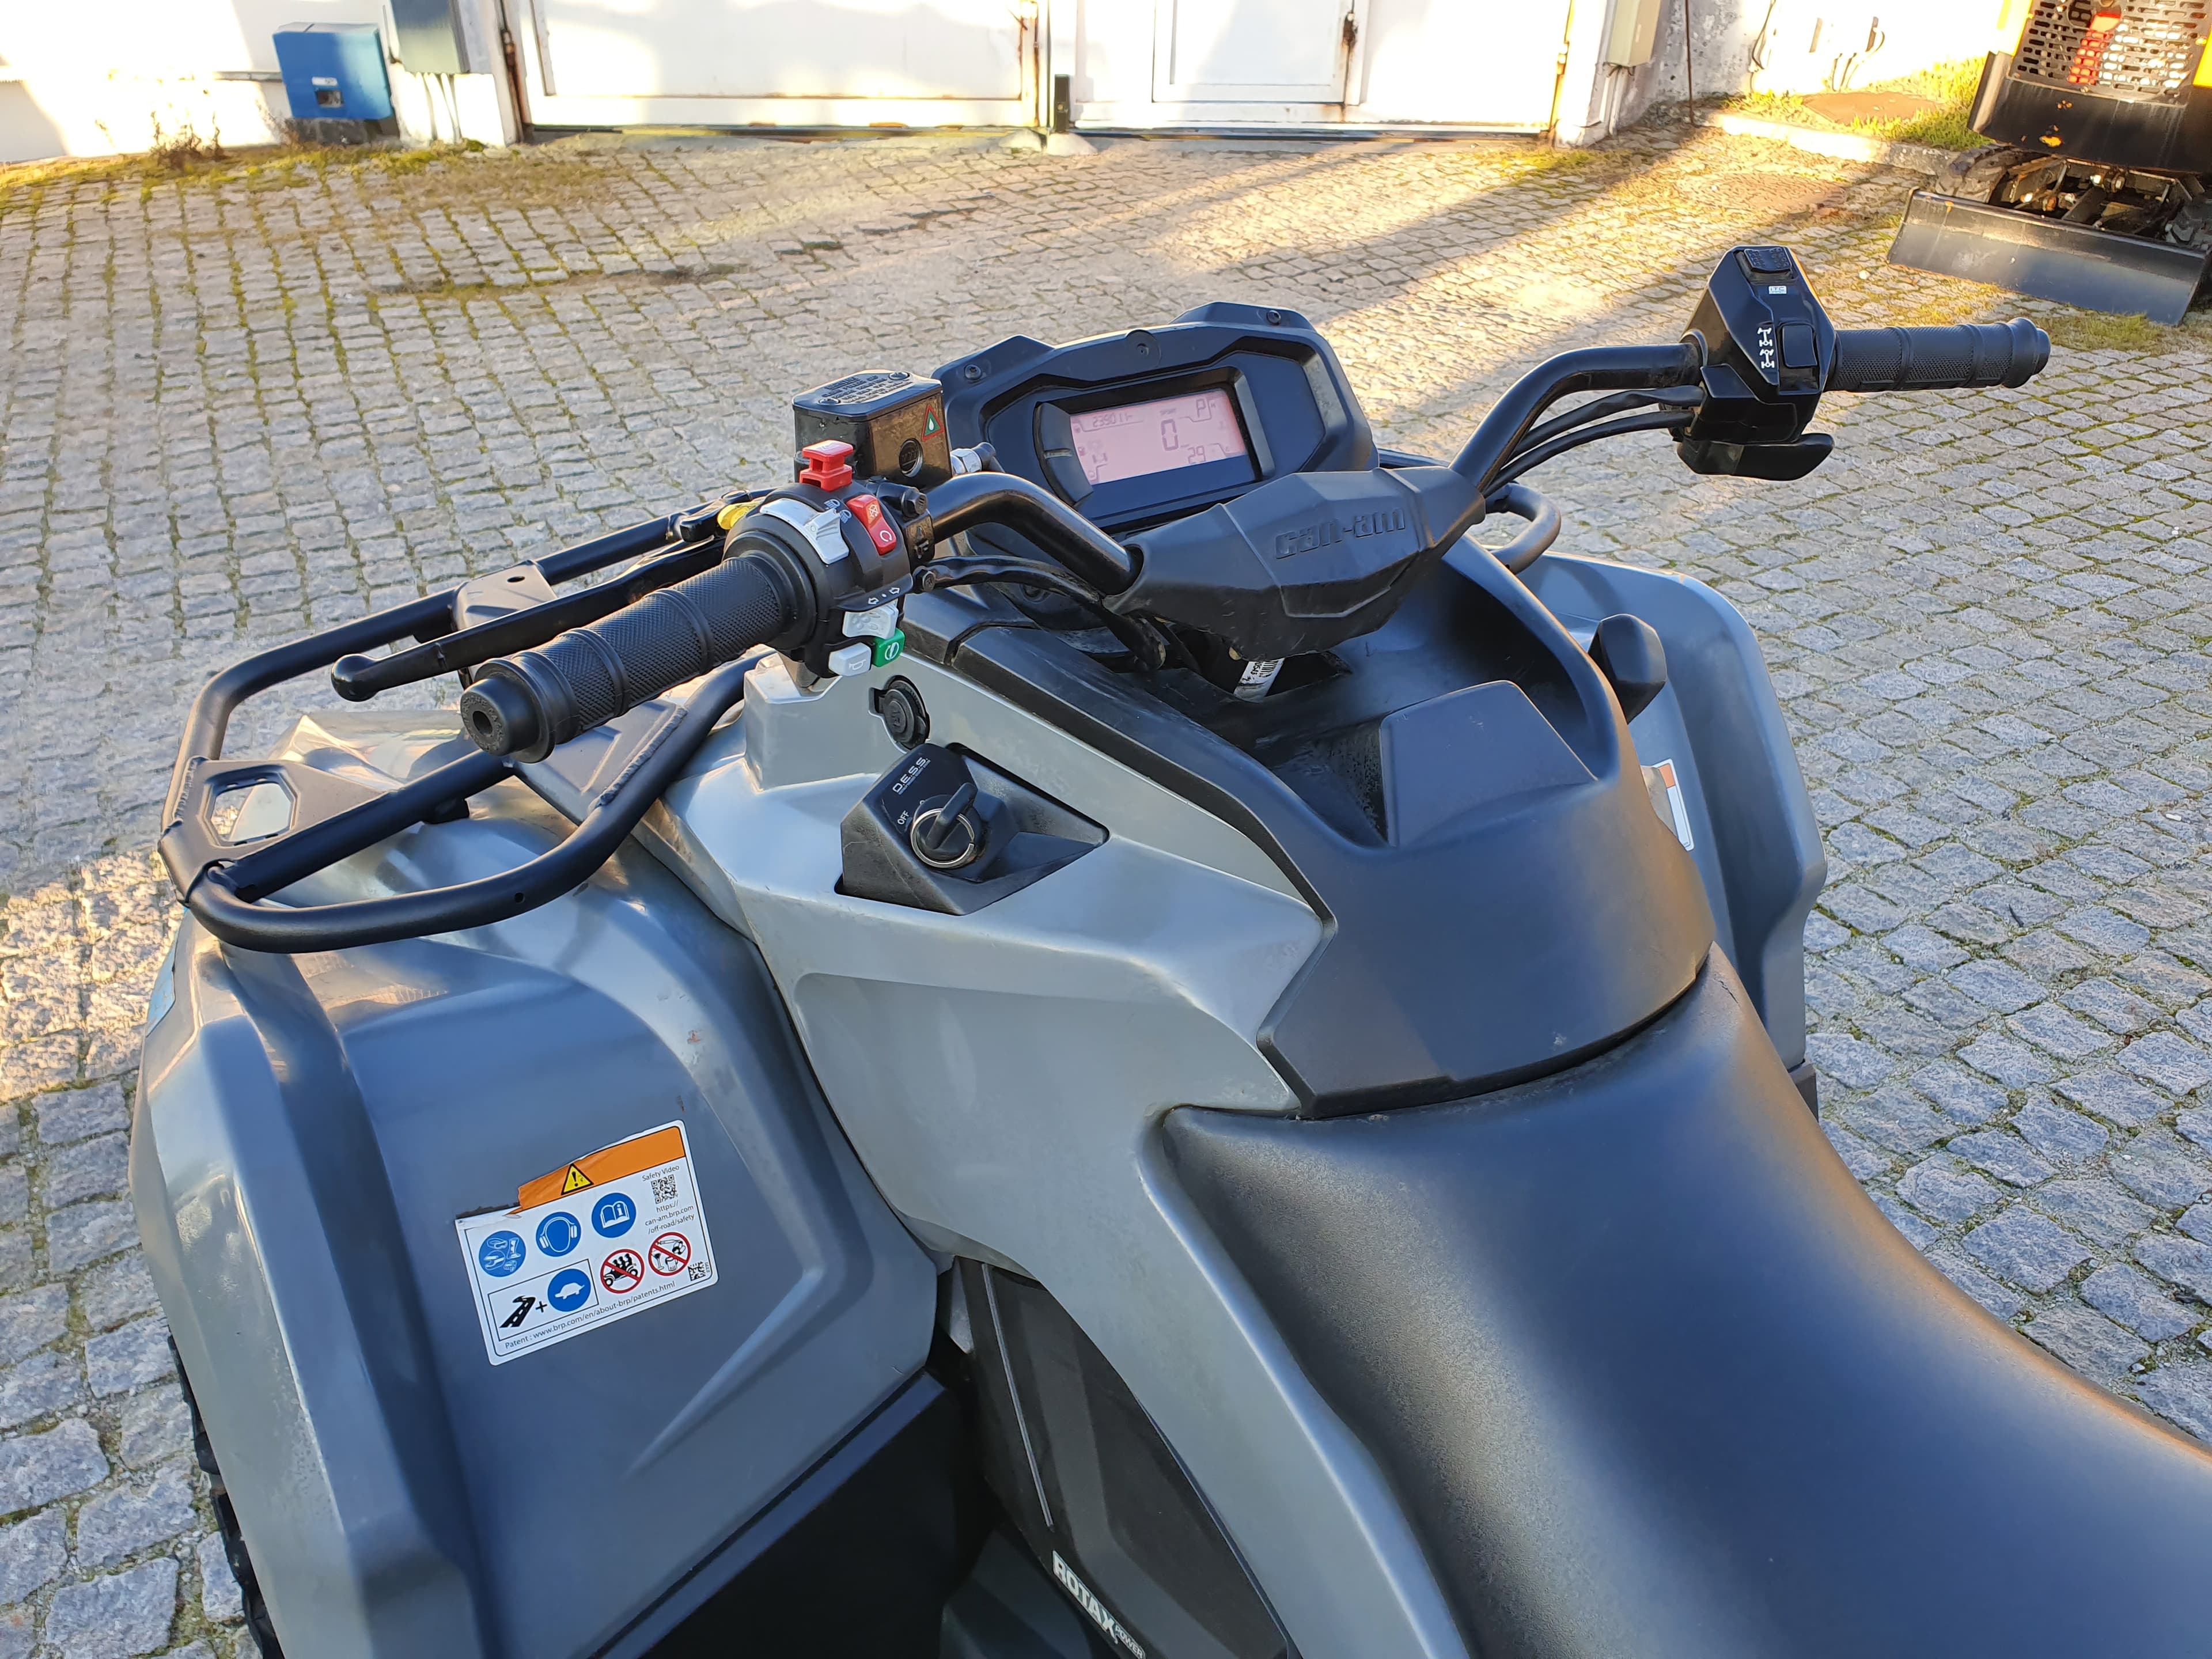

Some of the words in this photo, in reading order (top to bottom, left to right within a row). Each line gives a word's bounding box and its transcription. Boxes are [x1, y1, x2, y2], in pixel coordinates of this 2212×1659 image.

[1160, 419, 1179, 452] 0
[897, 810, 910, 825] OFF
[642, 1171, 661, 1181] Safety
[661, 1165, 680, 1175] Video
[645, 1205, 694, 1226] can-am.brp.com
[656, 1200, 679, 1213] https://
[648, 1213, 695, 1234] /off-road/safety
[505, 1335, 529, 1349] Patent
[533, 1281, 676, 1339] www.brp.com/en/about-brp/patents.html
[1053, 1551, 1118, 1645] ROTAX
[1115, 1624, 1143, 1659] POWER
